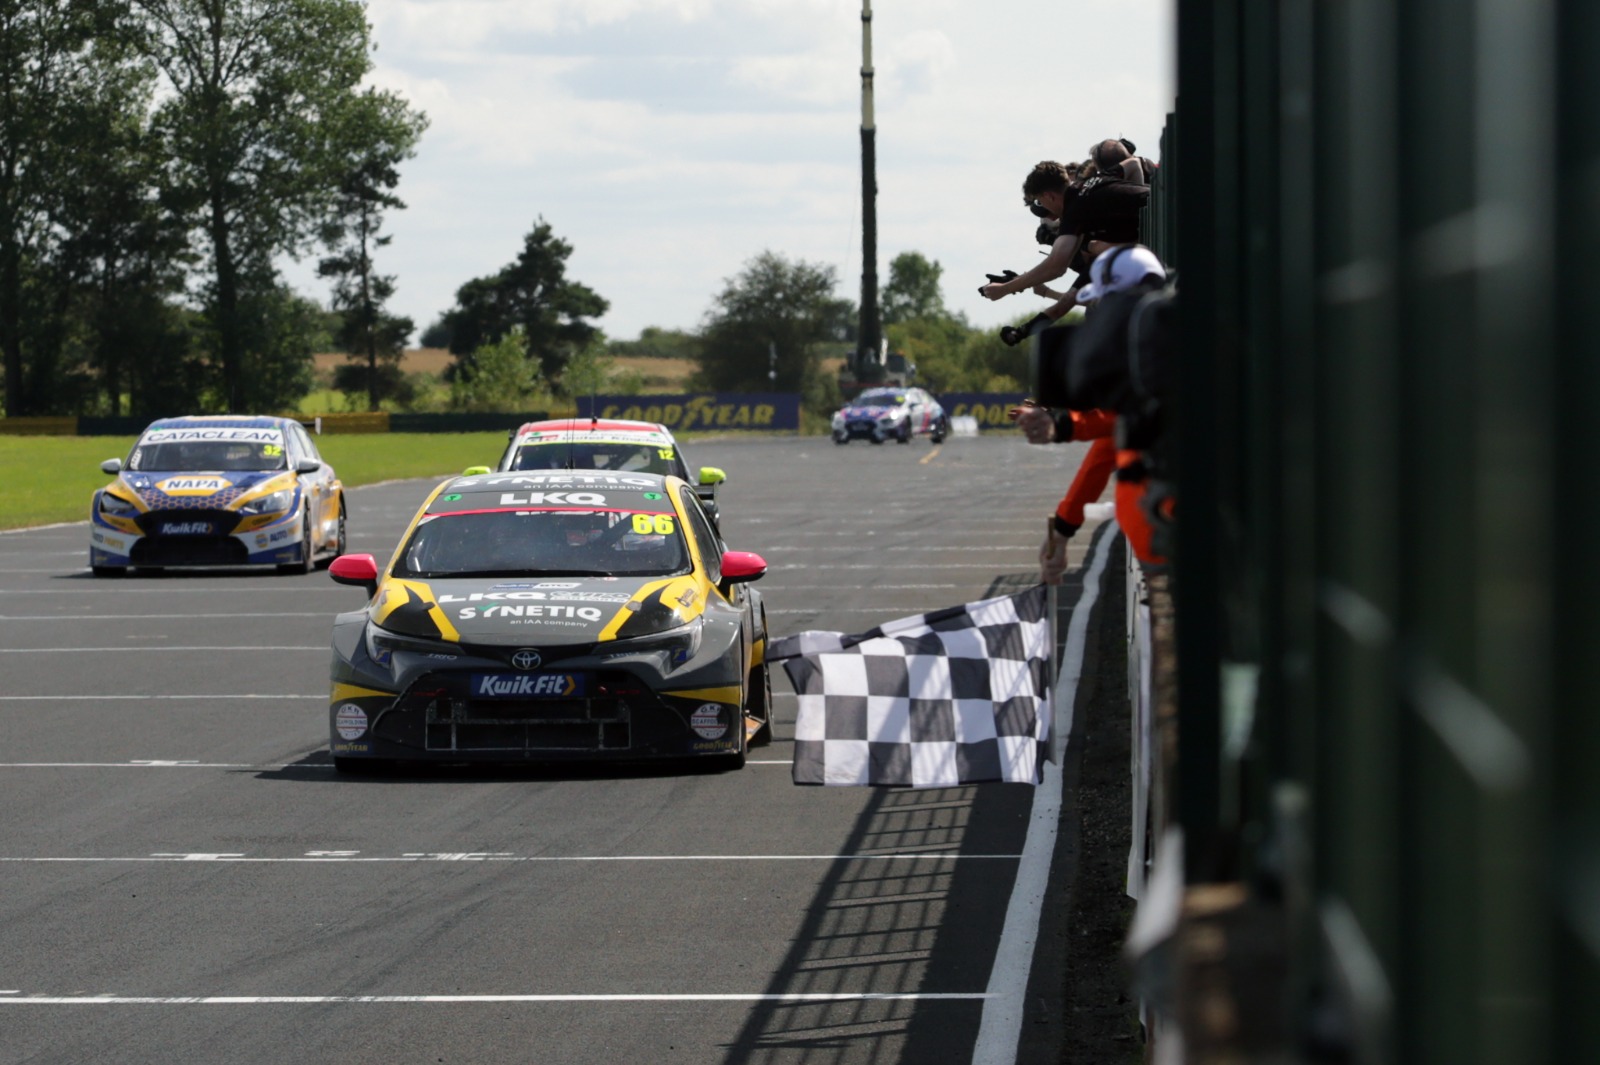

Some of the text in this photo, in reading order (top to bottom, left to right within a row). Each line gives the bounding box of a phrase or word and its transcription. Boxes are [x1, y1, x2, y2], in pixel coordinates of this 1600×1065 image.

[602, 399, 774, 428] GOODYEAR
[147, 430, 280, 442] CATACLEAN
[263, 445, 282, 456] 32
[658, 449, 675, 460] 12
[167, 480, 220, 489] NAPA
[576, 483, 644, 491] company
[500, 492, 608, 506] LKQ
[632, 514, 674, 535] 66
[438, 591, 549, 603] LKQ
[459, 603, 602, 621] SYNETIQ
[544, 619, 588, 628] company
